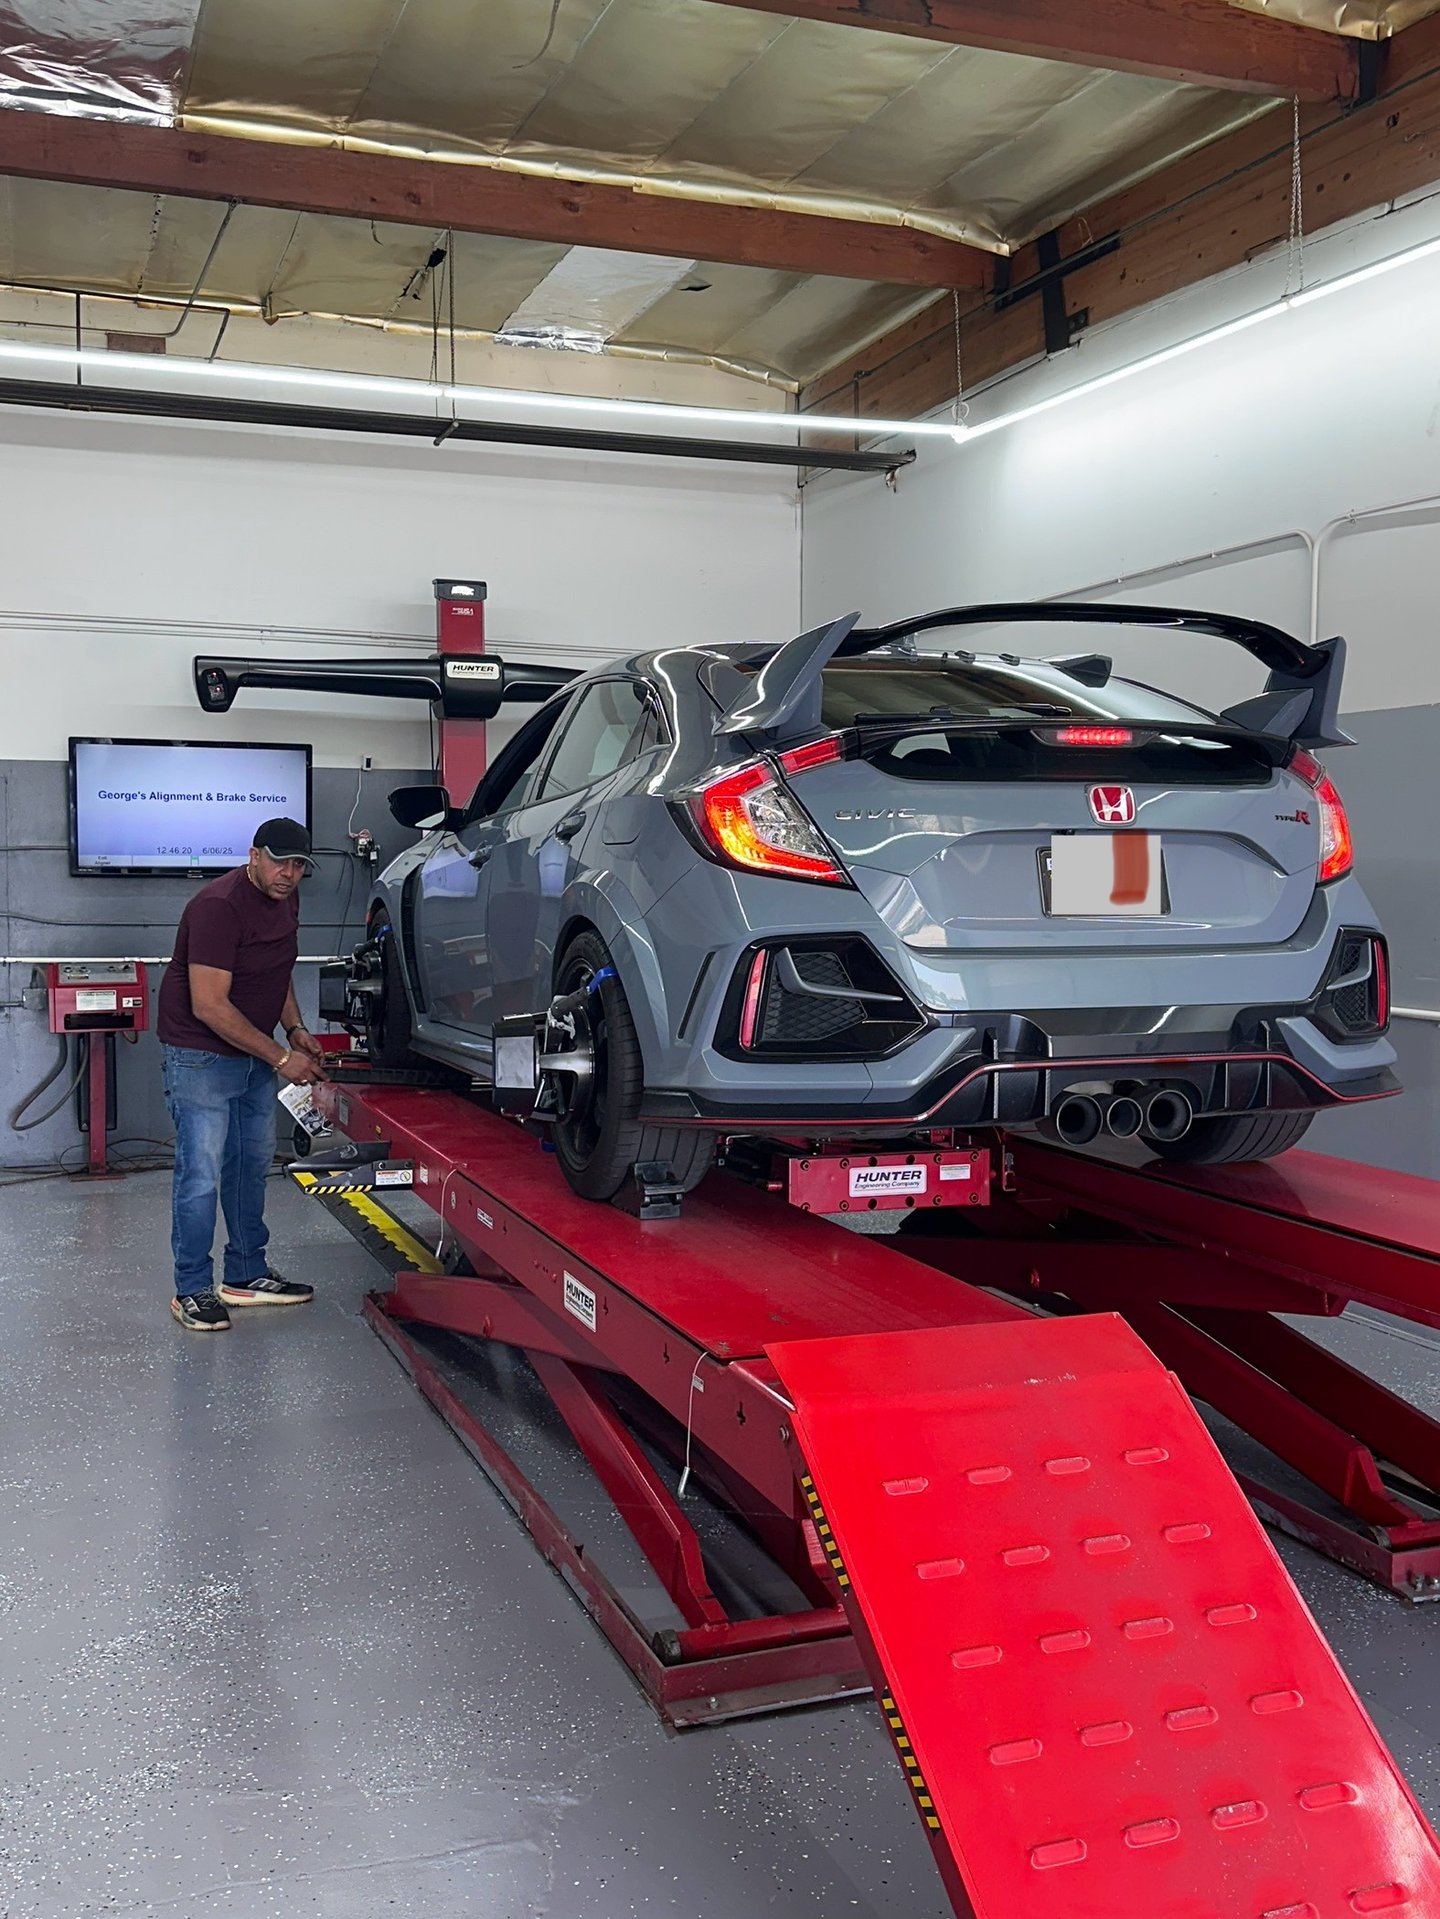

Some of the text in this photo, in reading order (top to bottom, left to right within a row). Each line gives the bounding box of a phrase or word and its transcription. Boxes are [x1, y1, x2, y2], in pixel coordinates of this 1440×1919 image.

[452, 664, 494, 672] HUNTER
[98, 790, 287, 802] George's Alignment & Brake Service
[834, 808, 916, 820] CIVIC
[202, 847, 233, 855] 6/06/25
[856, 1170, 922, 1182] HUNTER
[566, 1280, 594, 1312] HUNTER
